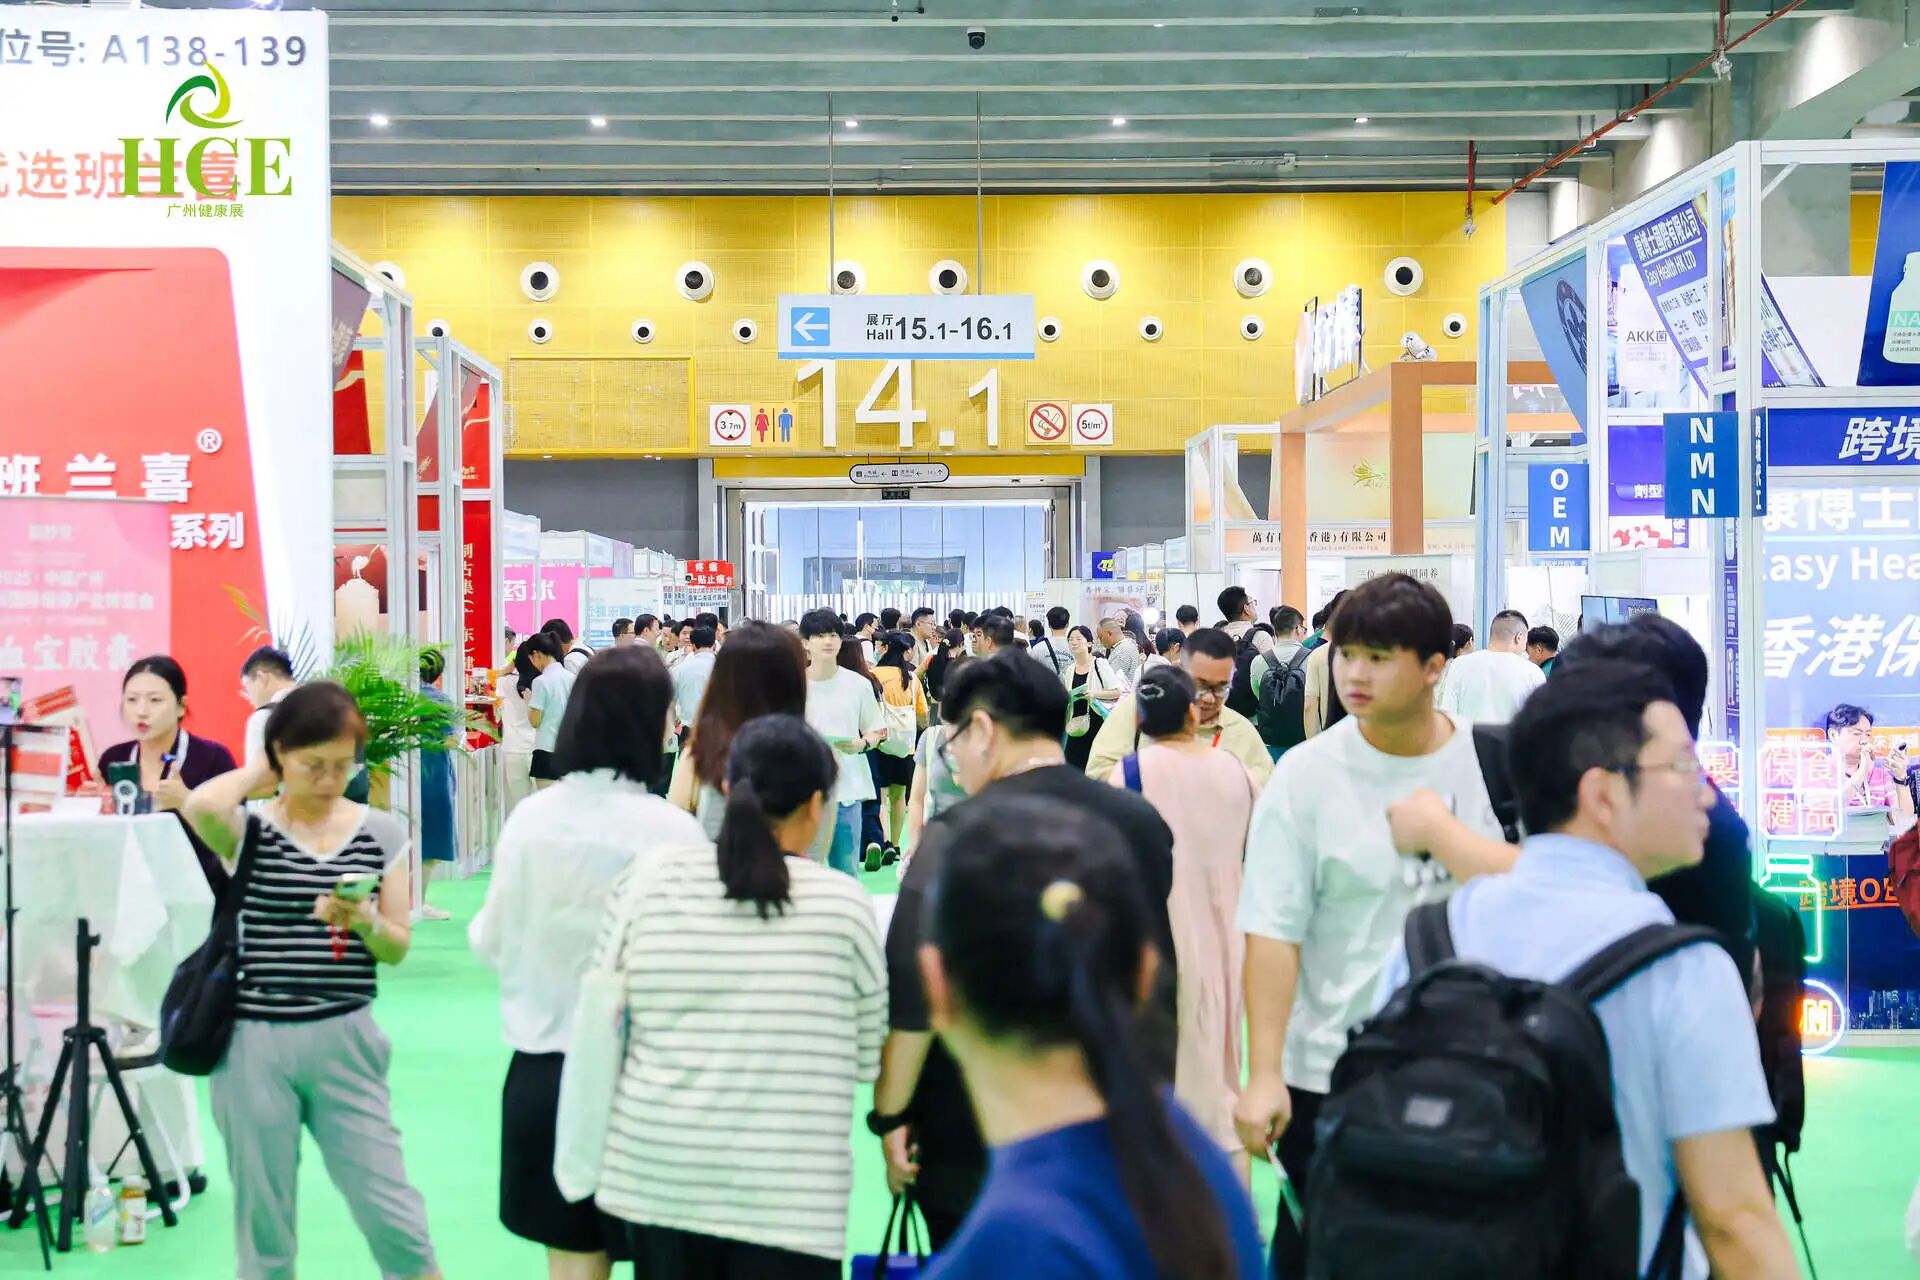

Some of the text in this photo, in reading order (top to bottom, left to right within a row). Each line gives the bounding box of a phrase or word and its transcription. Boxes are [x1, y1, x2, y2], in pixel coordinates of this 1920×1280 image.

[102, 35, 307, 67] A138-139
[866, 313, 894, 326] 展厅
[866, 317, 1013, 341] Hall 15.1-16.1
[797, 359, 998, 448] 14.1
[1688, 416, 1716, 515] NMN
[1549, 468, 1571, 548] OEM
[1763, 487, 1920, 532] 康博士
[170, 511, 245, 550] 系列
[1763, 546, 1839, 590] asy
